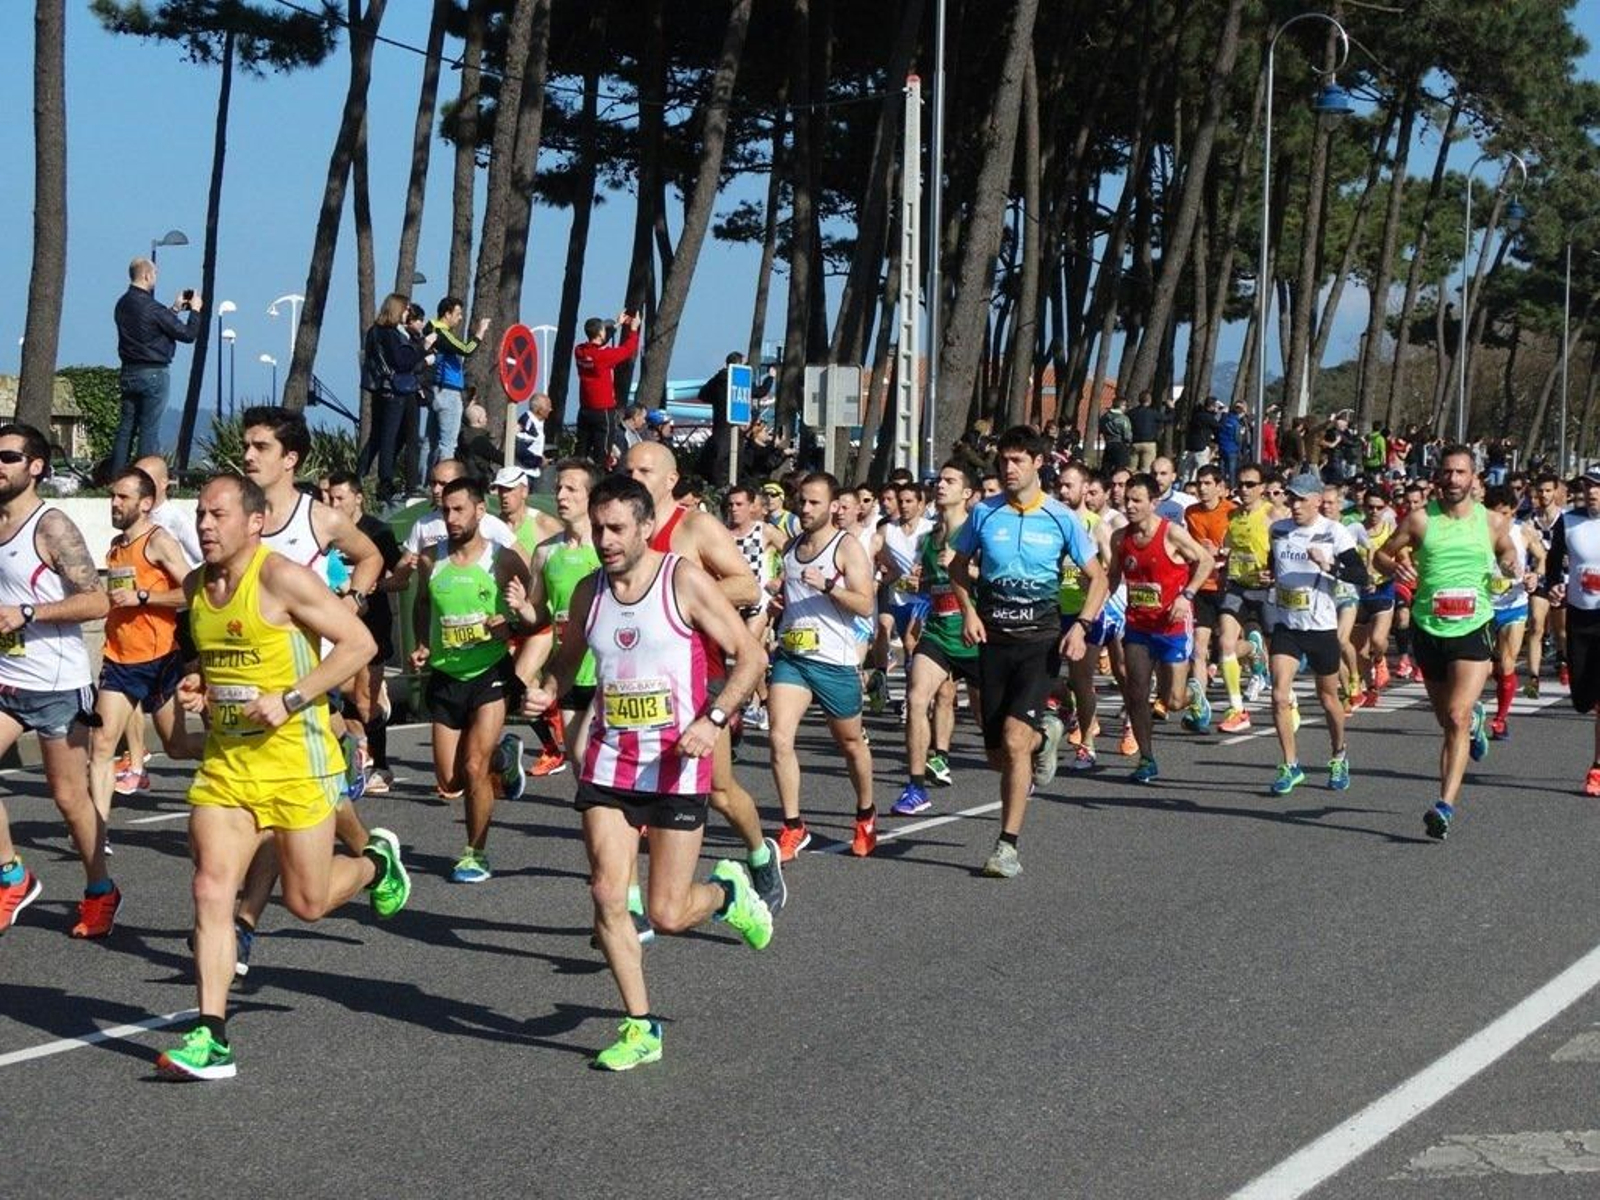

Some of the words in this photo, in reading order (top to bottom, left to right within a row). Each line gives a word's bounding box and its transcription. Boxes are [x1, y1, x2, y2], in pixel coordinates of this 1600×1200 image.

[453, 627, 476, 643] 108
[219, 705, 238, 726] 26
[617, 696, 658, 719] 4013
